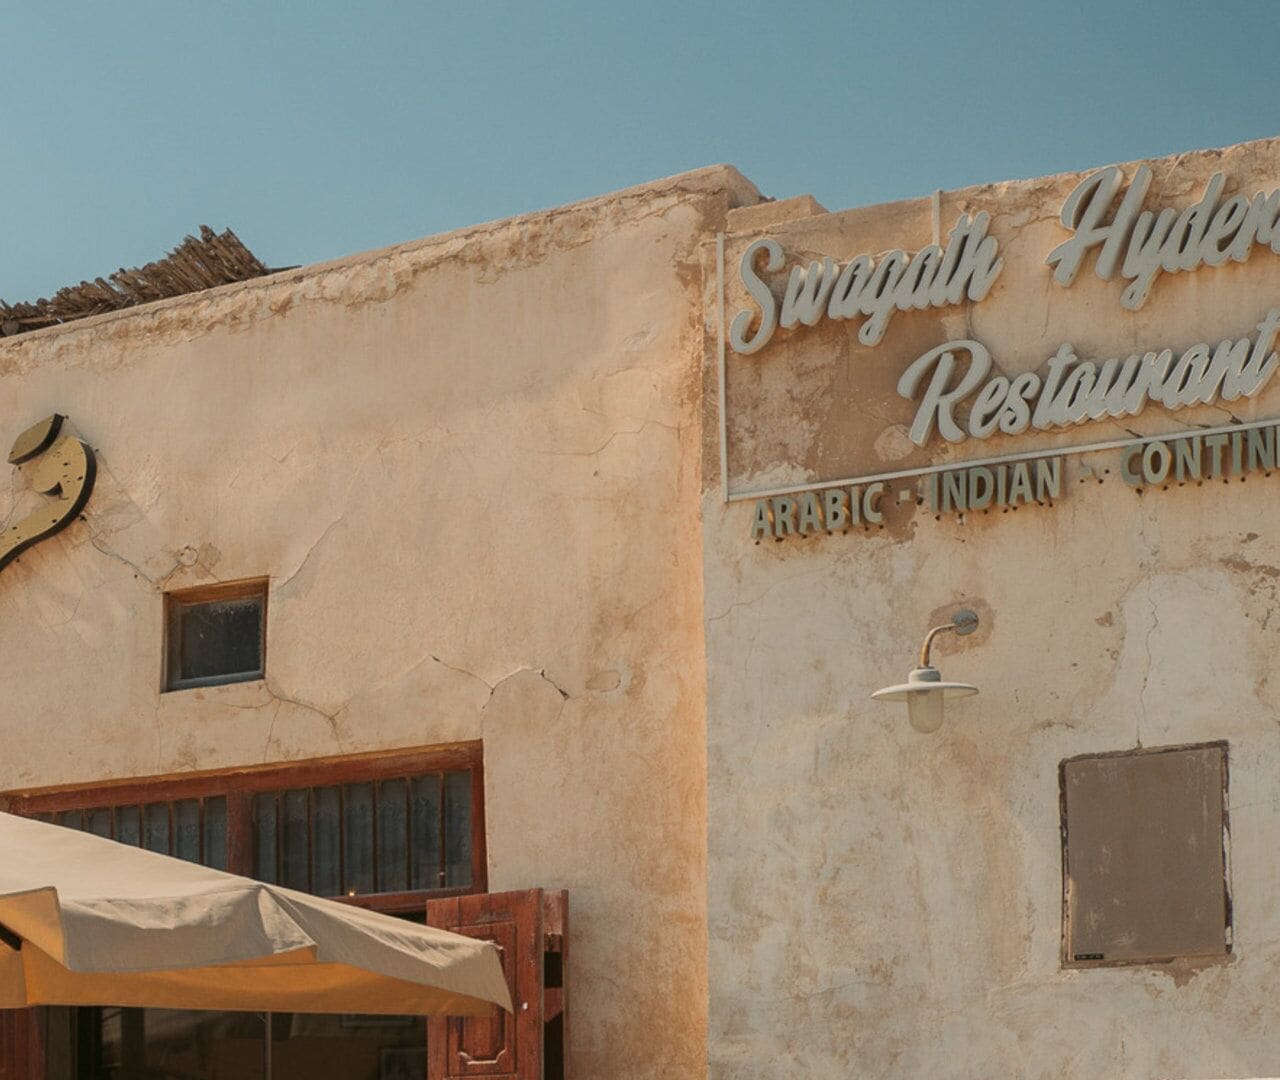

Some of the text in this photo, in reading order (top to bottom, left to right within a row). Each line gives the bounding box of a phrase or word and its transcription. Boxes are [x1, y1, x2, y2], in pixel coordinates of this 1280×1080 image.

[730, 164, 1280, 354] Swagath Hyder
[896, 309, 1280, 447] Restaurant
[751, 482, 884, 539] ARABIC
[928, 455, 1062, 513] INDIAN
[1120, 424, 1280, 487] CONTIN
